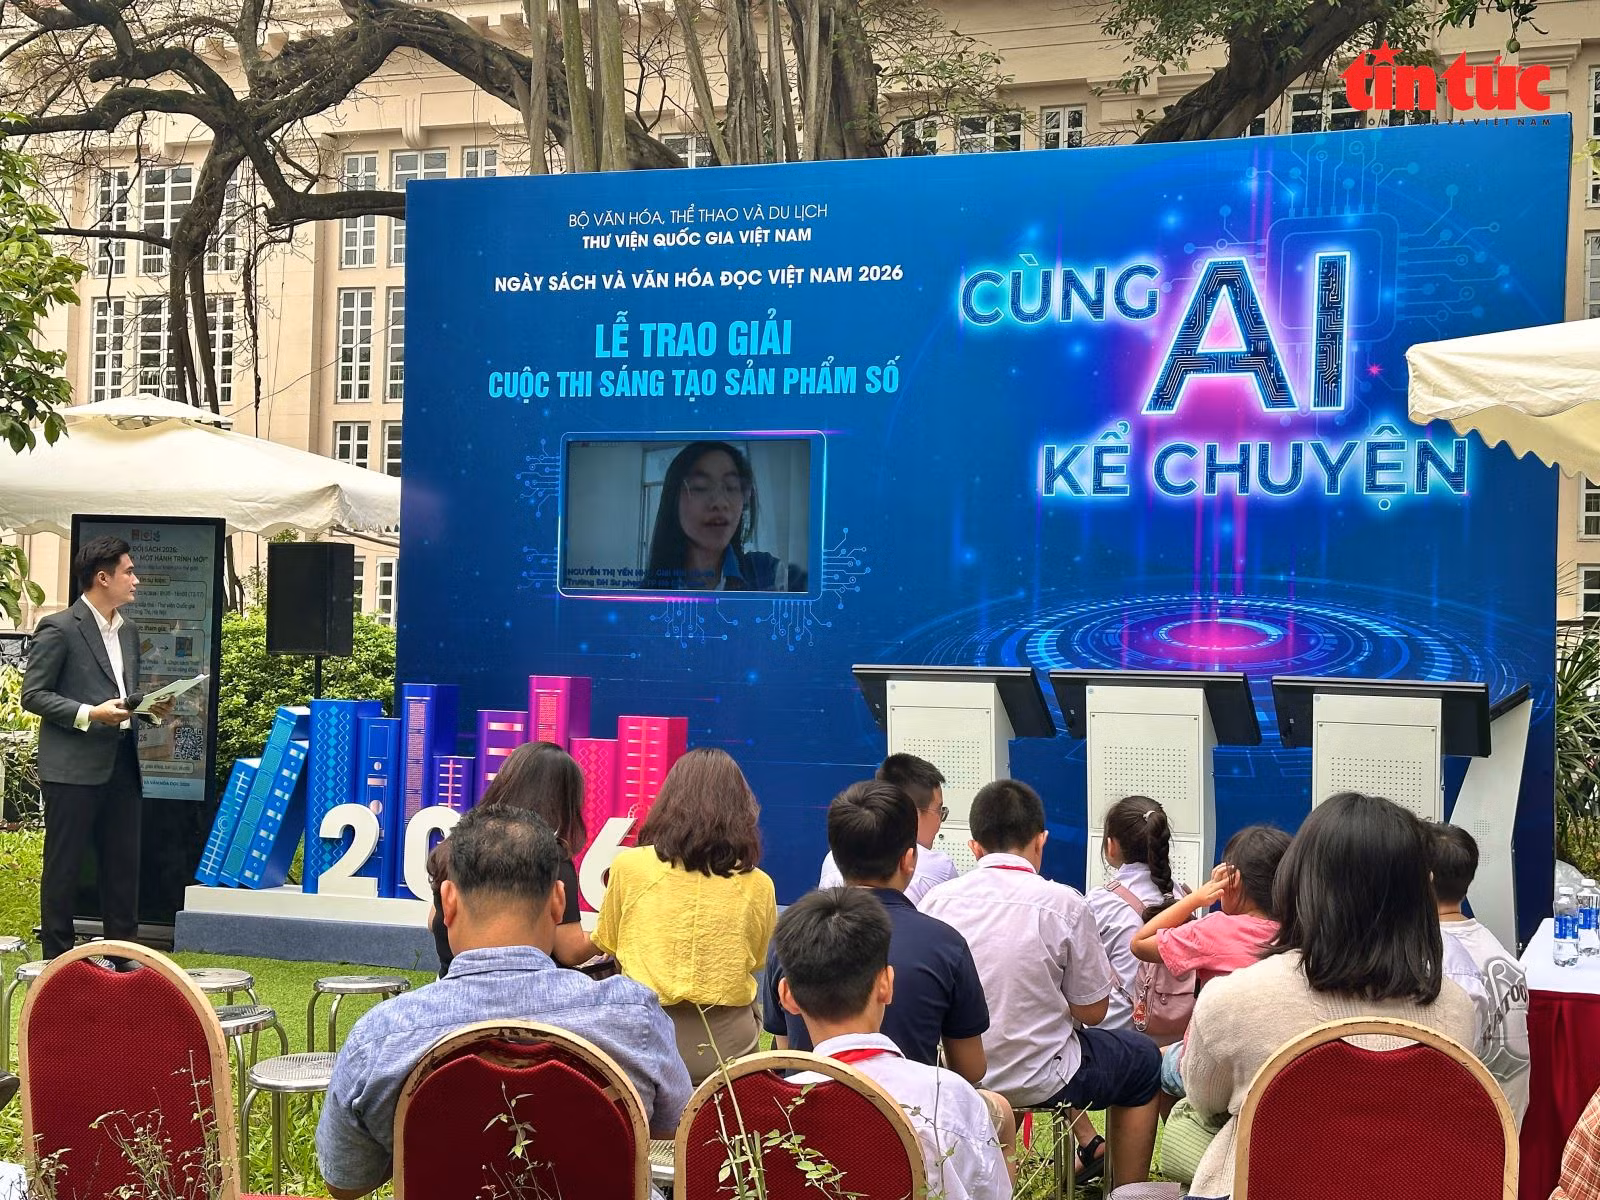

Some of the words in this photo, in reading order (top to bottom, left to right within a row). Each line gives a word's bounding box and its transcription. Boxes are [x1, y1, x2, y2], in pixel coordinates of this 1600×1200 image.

[569, 211, 590, 230] BỘ
[593, 211, 625, 226] VĂN
[629, 209, 665, 226] HÓA,
[670, 204, 695, 224] THỂ
[698, 208, 739, 223] THAO
[742, 204, 765, 221] VÀ
[769, 206, 790, 220] DU
[795, 204, 829, 223] LỊCH
[582, 234, 612, 249] THƯ
[614, 231, 649, 251] VIỆN
[652, 227, 701, 247] QUỐC
[705, 231, 735, 245] GIA
[738, 226, 771, 247] VIỆT
[774, 228, 812, 243] NAM
[494, 273, 544, 292] NGÀY
[548, 272, 597, 291] SÁCH
[601, 270, 627, 290] VÀ
[631, 270, 669, 289] VĂN
[674, 268, 715, 288] HÓA
[719, 270, 763, 290] ĐỌC
[767, 265, 805, 289] VIỆT
[809, 267, 853, 283] NAM
[858, 264, 904, 282] 2026
[595, 311, 629, 358] LỄ
[639, 322, 717, 358] TRAO
[728, 308, 792, 356] GIẢI
[960, 253, 1160, 325] CÙNG
[1140, 250, 1352, 415] AI
[488, 367, 550, 404] CUỘC
[556, 371, 593, 398] THI
[599, 365, 665, 397] SÁNG
[671, 369, 717, 402] TẠO
[724, 360, 776, 396] SẢN
[783, 356, 857, 394] PHẨM
[865, 355, 900, 393] SỐ
[1042, 421, 1131, 497] KỂ
[1152, 423, 1469, 511] CHUYỆN
